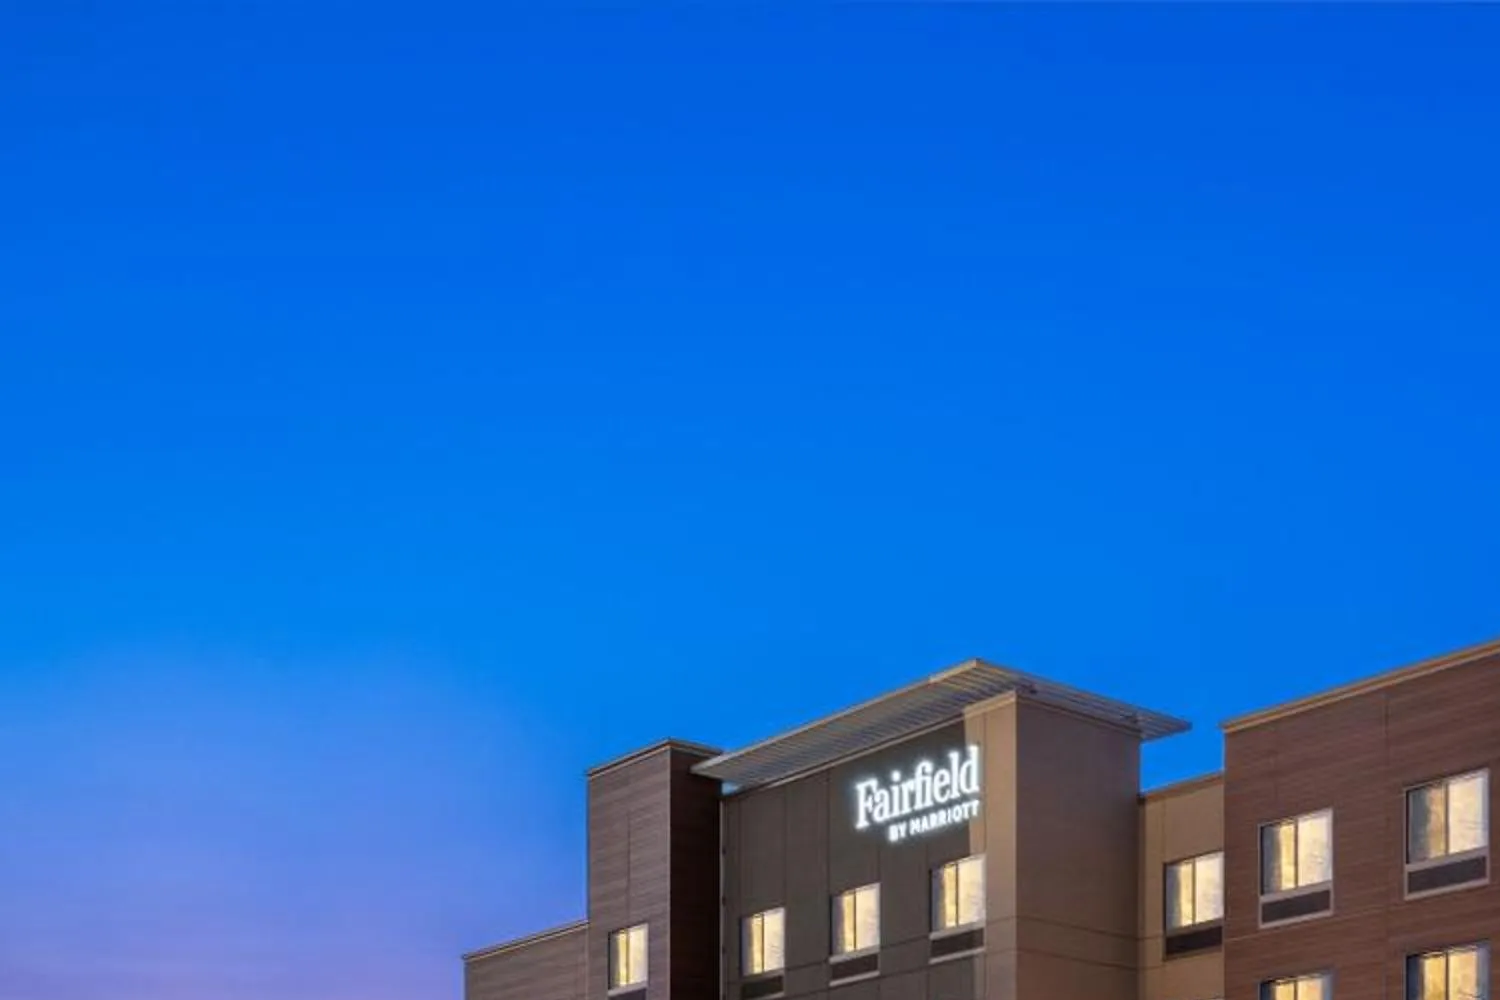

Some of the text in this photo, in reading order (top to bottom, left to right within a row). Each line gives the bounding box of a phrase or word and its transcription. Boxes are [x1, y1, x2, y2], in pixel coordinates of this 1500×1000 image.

[855, 744, 980, 829] Fairfield
[888, 800, 980, 842] BY MARRIOTT
